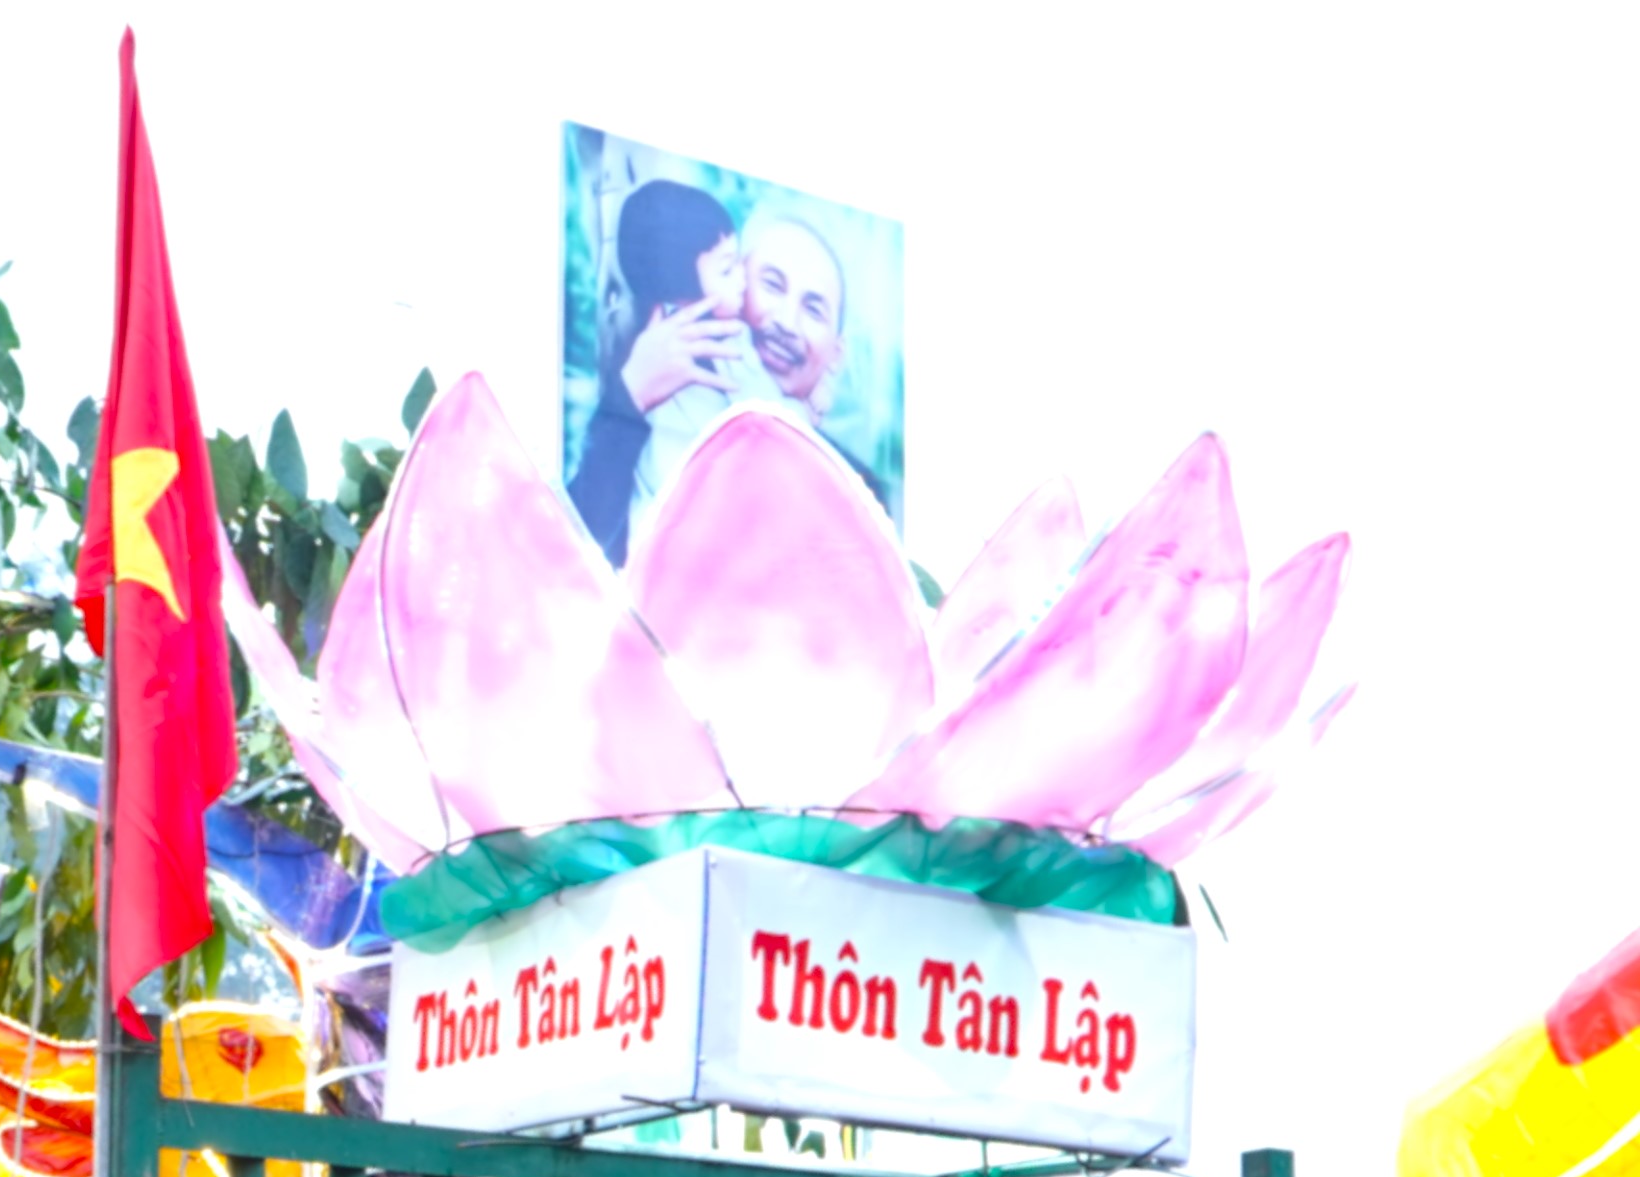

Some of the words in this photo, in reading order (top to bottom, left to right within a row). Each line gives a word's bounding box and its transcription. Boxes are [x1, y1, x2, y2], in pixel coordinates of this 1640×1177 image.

[413, 980, 500, 1073] Thôn
[515, 958, 581, 1049] Tân
[593, 936, 666, 1050] Lập
[751, 931, 897, 1041] Thôn
[919, 959, 1020, 1058] Tân
[1039, 978, 1137, 1093] Lập
